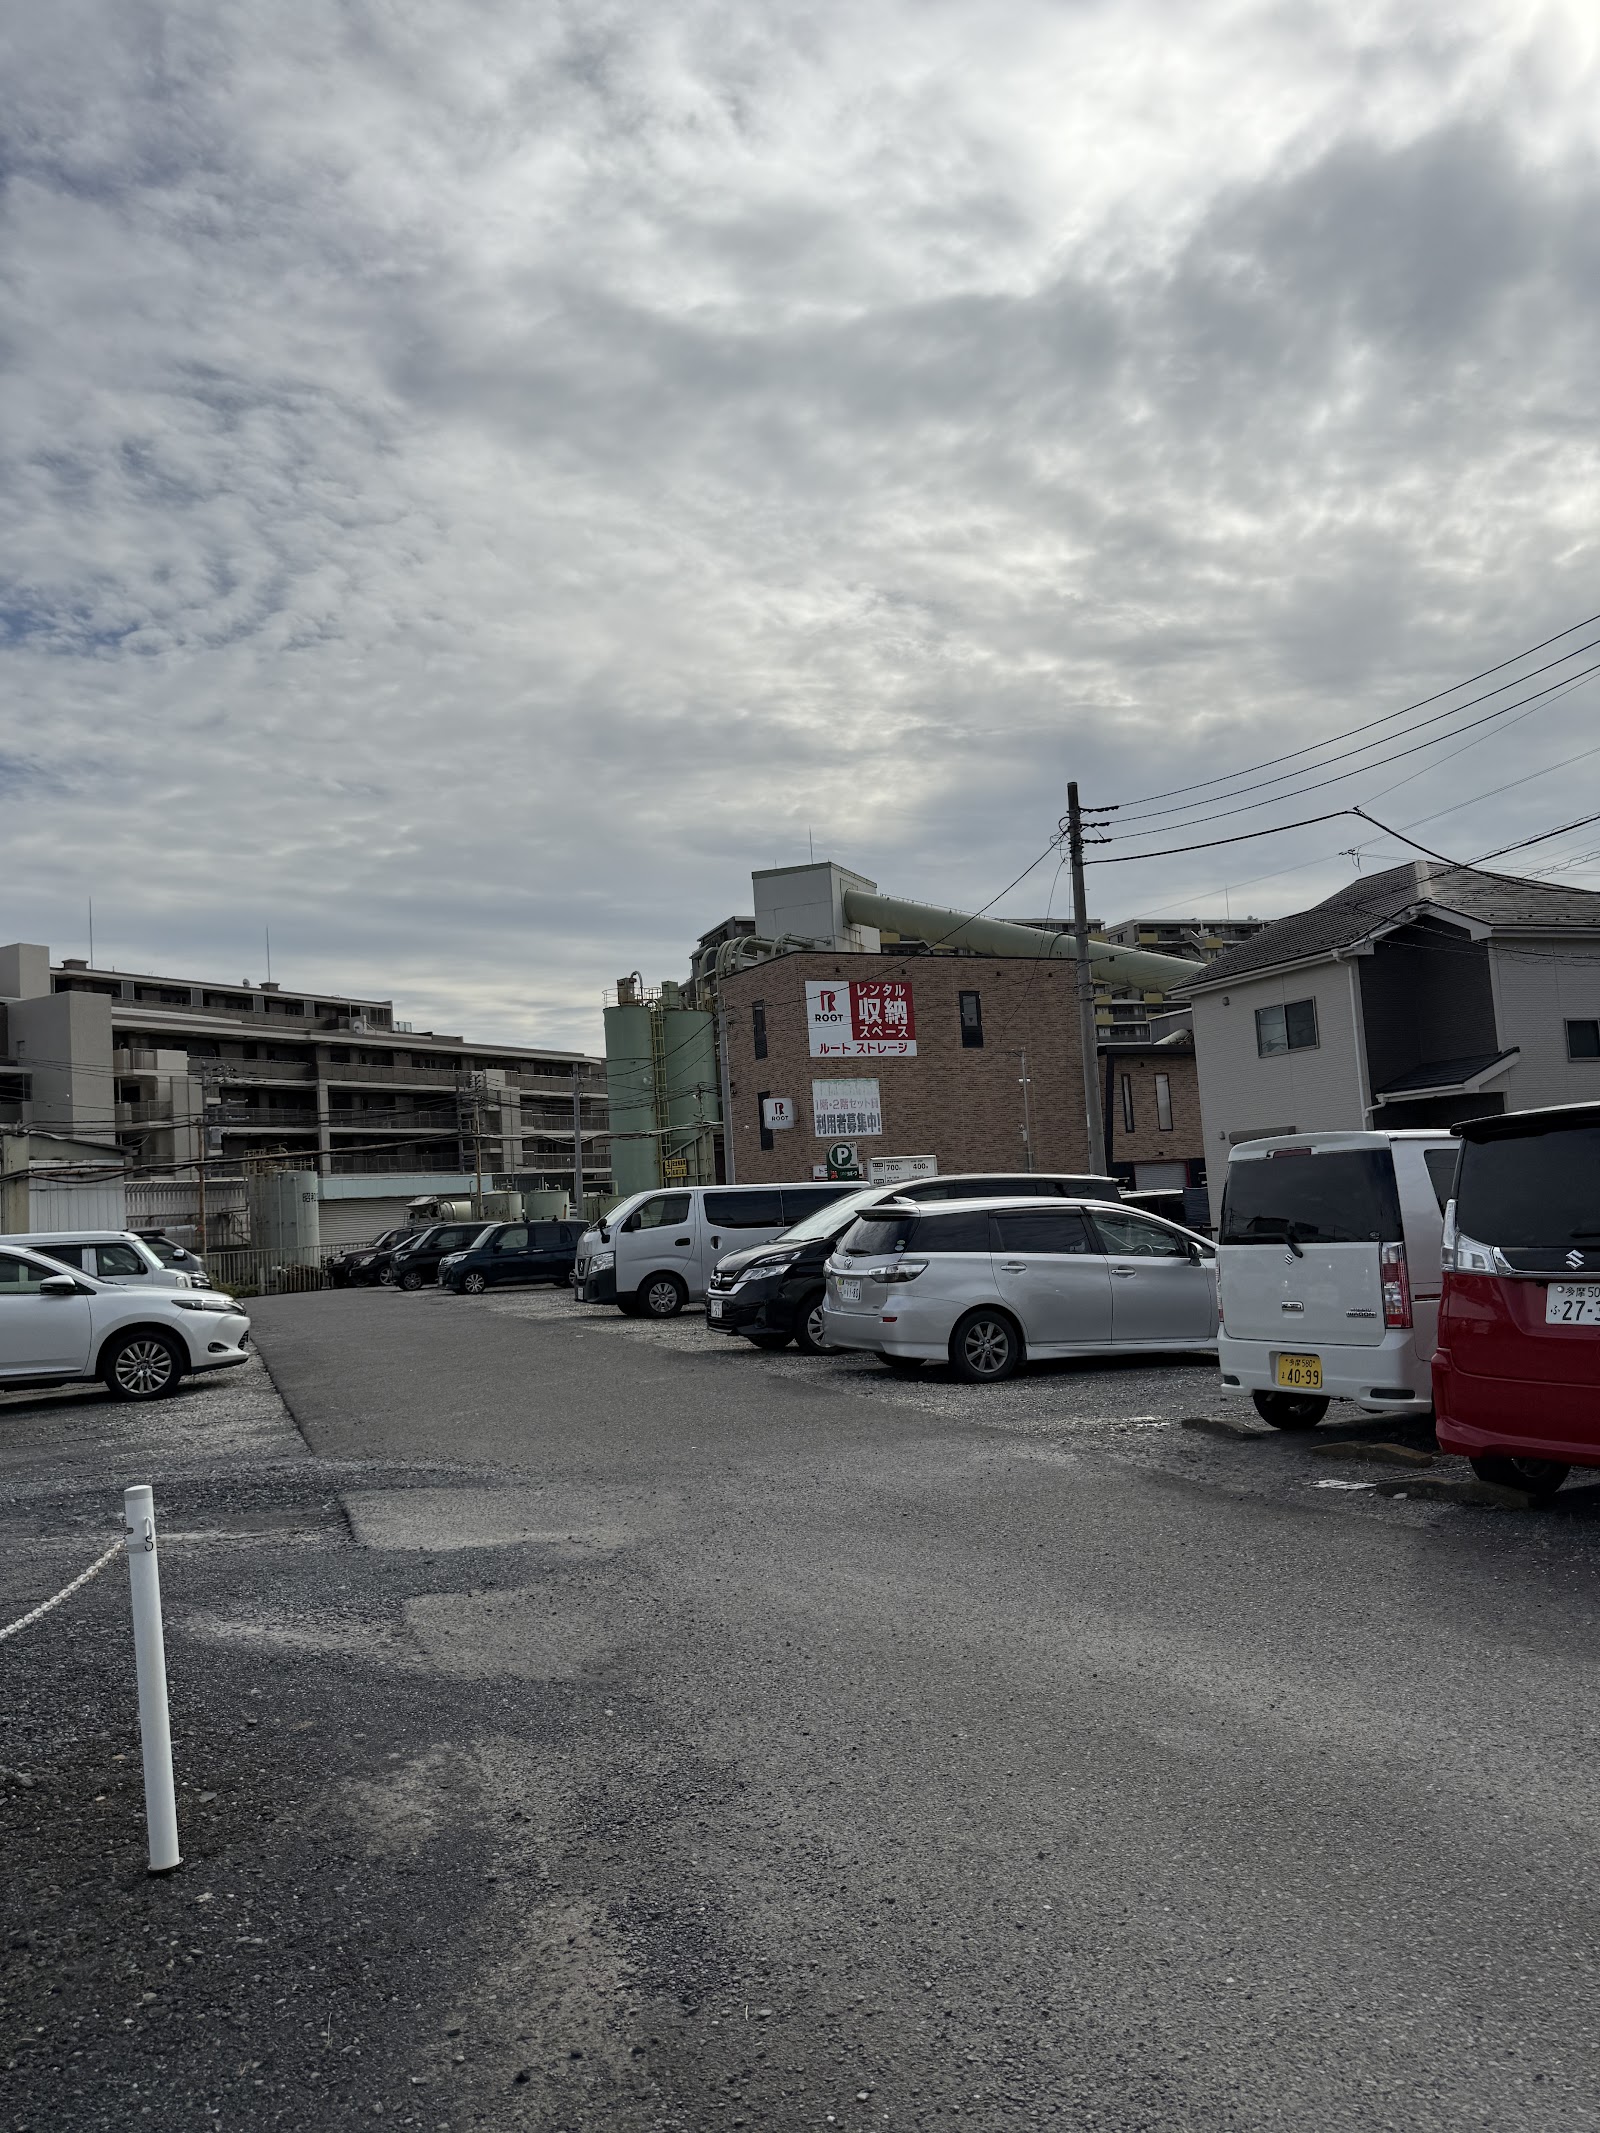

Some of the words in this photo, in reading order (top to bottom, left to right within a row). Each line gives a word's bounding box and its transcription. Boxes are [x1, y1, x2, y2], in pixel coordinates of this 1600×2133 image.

[856, 983, 906, 997] レンタル
[858, 997, 908, 1025] 収納
[814, 1014, 844, 1022] ROOT
[859, 1025, 909, 1038] スペース
[819, 1043, 851, 1055] ルート
[856, 1042, 908, 1054] ストレージ
[836, 1147, 849, 1164] P
[1565, 1286, 1586, 1297] 多摩
[1550, 1304, 1561, 1315] ふ
[1301, 1359, 1313, 1368] 580
[1287, 1368, 1319, 1385] 40-99
